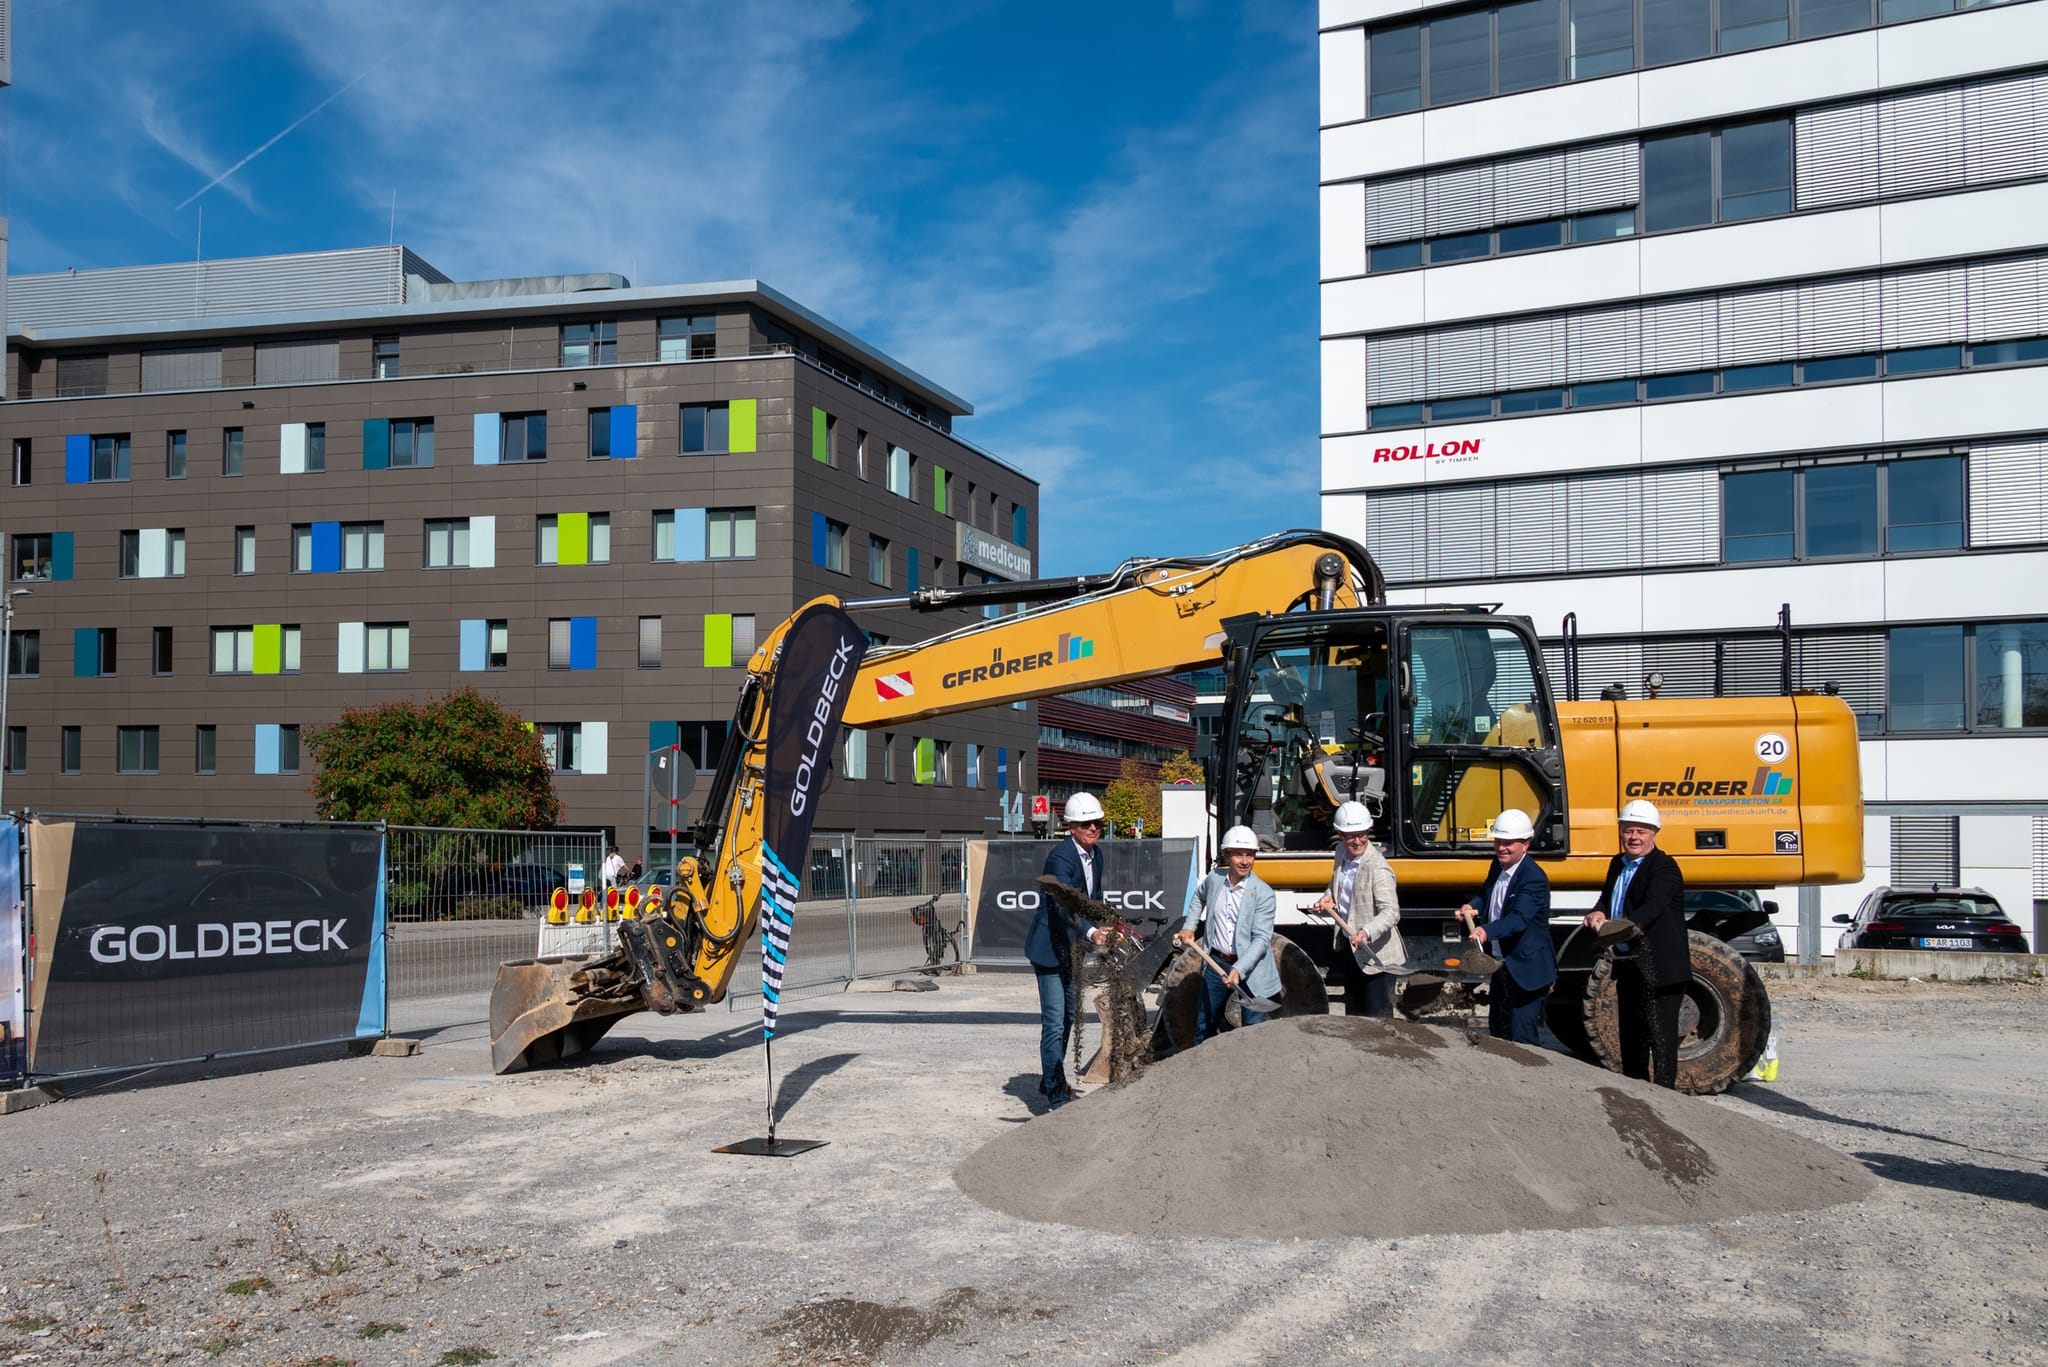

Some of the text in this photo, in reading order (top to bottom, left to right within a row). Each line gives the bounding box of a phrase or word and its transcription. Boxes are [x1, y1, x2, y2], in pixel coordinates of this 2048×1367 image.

[1373, 439, 1481, 463] ROLLON
[978, 540, 1031, 575] medicum
[942, 648, 1053, 689] GFRÖRER
[790, 635, 854, 817] GOLDBECK
[1760, 740, 1784, 756] 20
[1625, 766, 1748, 797] GFRÖRER
[999, 789, 1025, 832] 14
[1660, 808, 1699, 816] mpfingen
[1693, 797, 1769, 806] TRANSPORTBETON
[996, 890, 1166, 910] GOECK
[90, 918, 349, 964] GOLDBECK
[1925, 938, 1971, 947] S AR 1103
